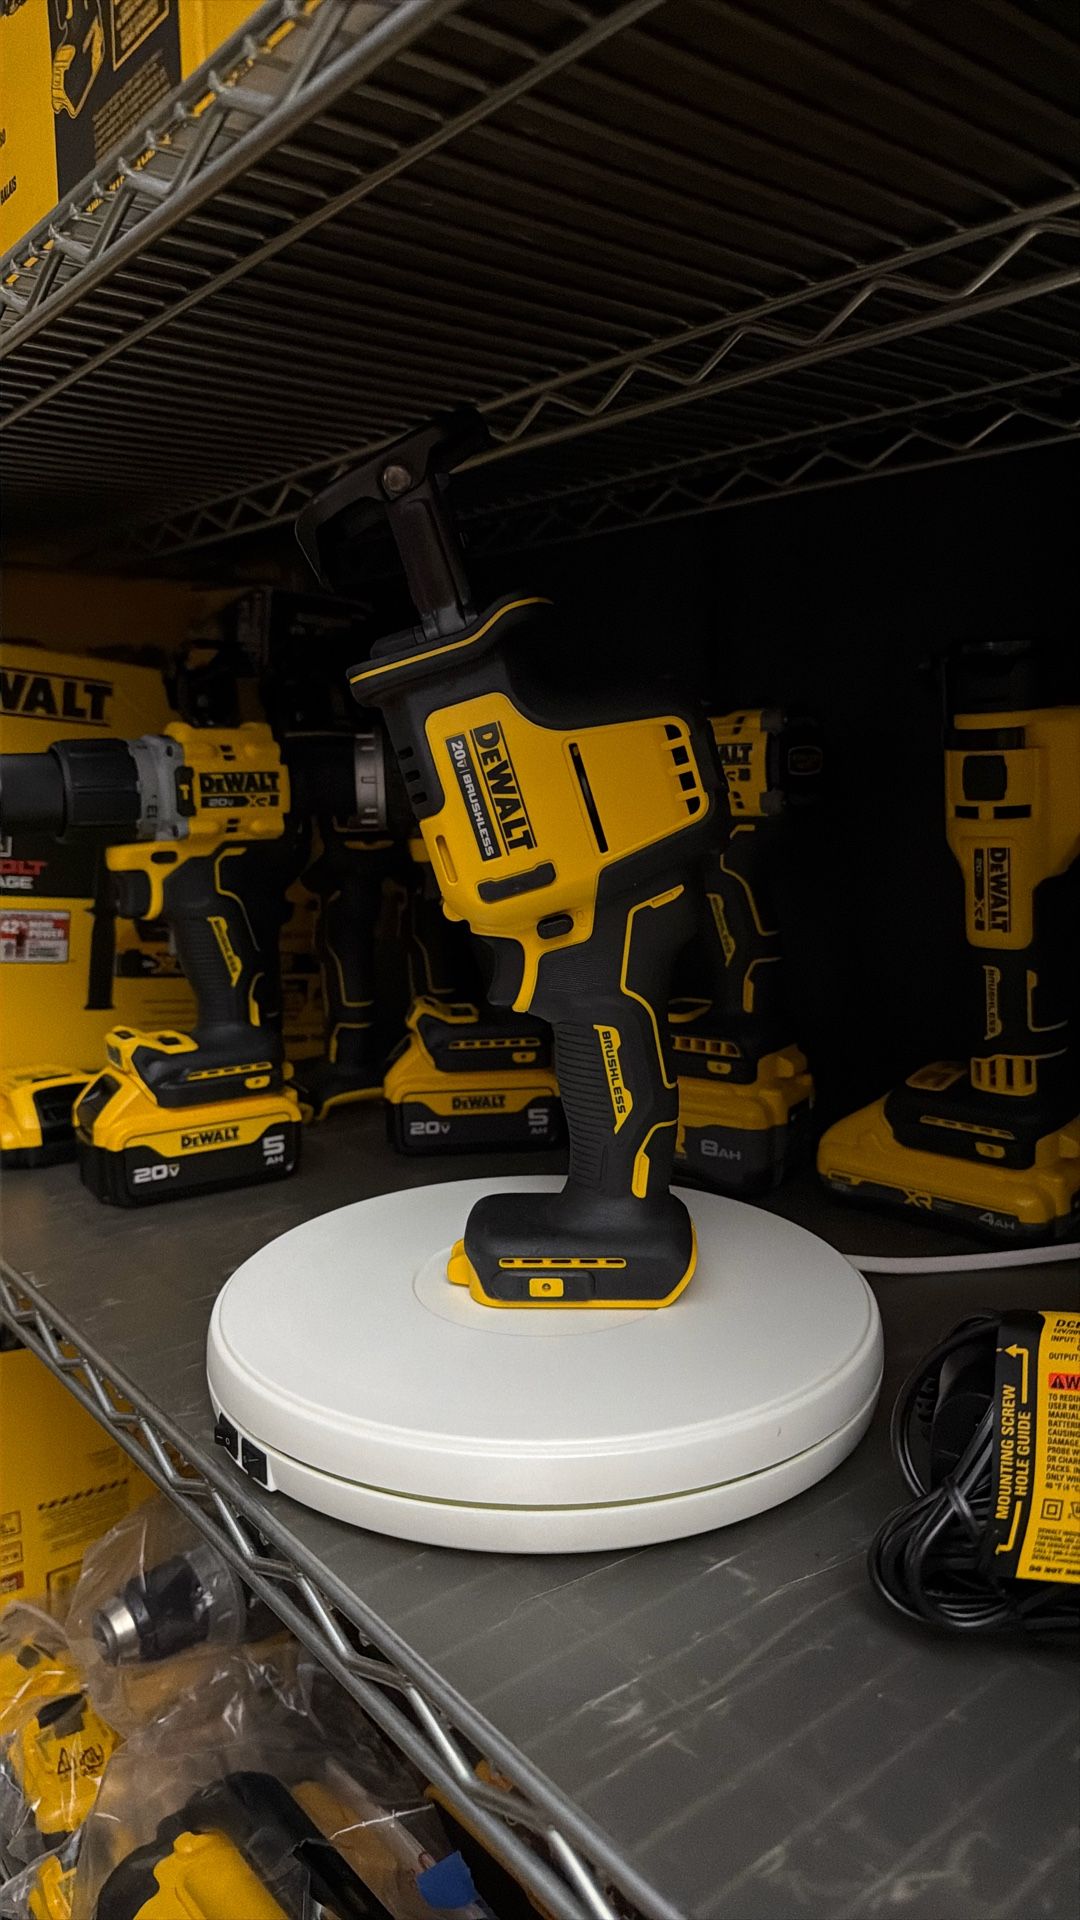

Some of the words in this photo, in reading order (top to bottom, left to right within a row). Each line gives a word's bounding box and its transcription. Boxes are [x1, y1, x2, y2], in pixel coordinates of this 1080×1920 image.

[200, 773, 279, 792] DEWALT
[473, 722, 534, 850] DEWALT
[463, 774, 494, 857] BRUSHLESS
[990, 847, 1008, 933] DEWALT
[602, 1031, 626, 1114] BRUSHLESS
[452, 1095, 505, 1110] DEWALT
[527, 1107, 549, 1127] 5
[181, 1126, 240, 1149] DEWALT
[262, 1134, 286, 1156] 5
[1001, 1384, 1016, 1436] SCREW
[1017, 1411, 1032, 1456] GUIDE
[994, 1439, 1014, 1520] MOUNTING
[1013, 1459, 1030, 1497] HOLE
